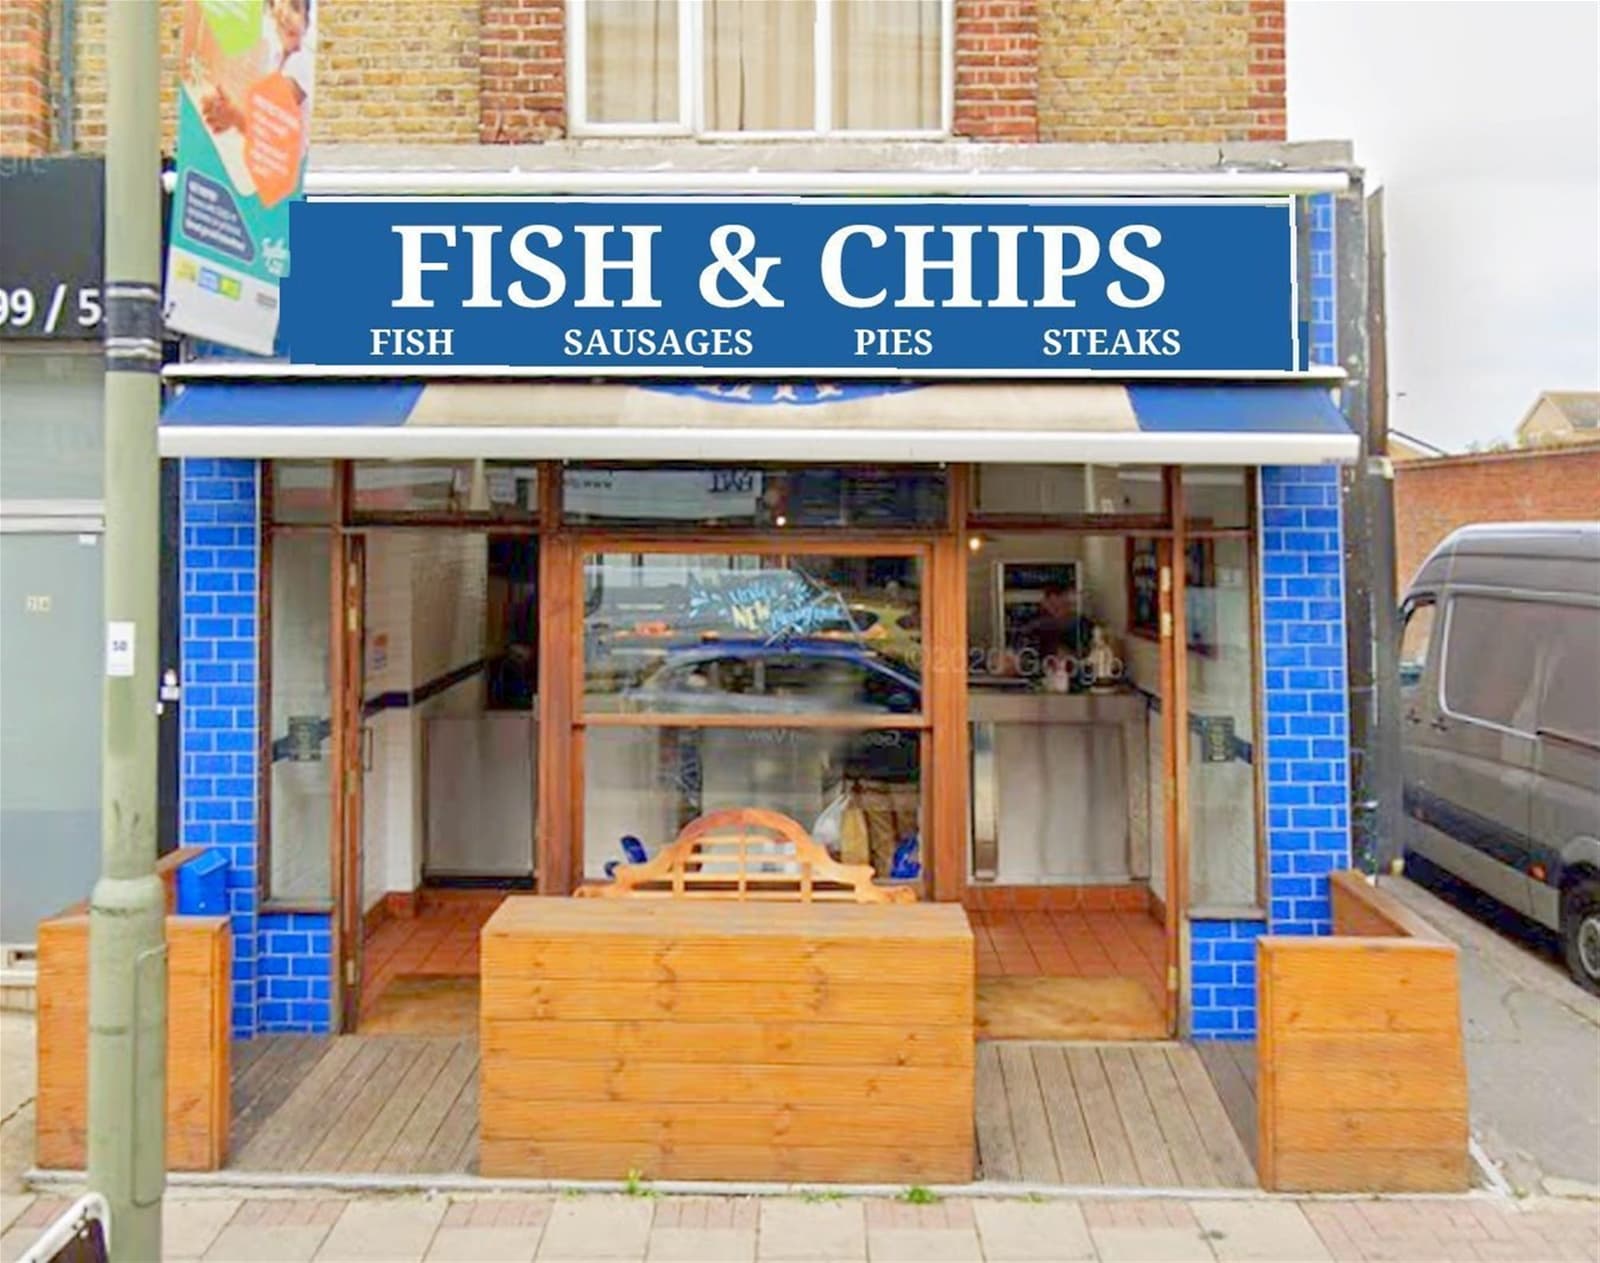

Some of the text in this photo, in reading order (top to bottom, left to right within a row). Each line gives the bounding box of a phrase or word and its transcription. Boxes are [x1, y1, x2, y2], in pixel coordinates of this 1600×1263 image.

[392, 225, 1164, 308] FISH & CHIPS
[371, 329, 453, 355] FISH
[565, 329, 752, 355] SAUSAGES
[855, 329, 932, 355] PIES
[1044, 329, 1180, 355] STEAKS
